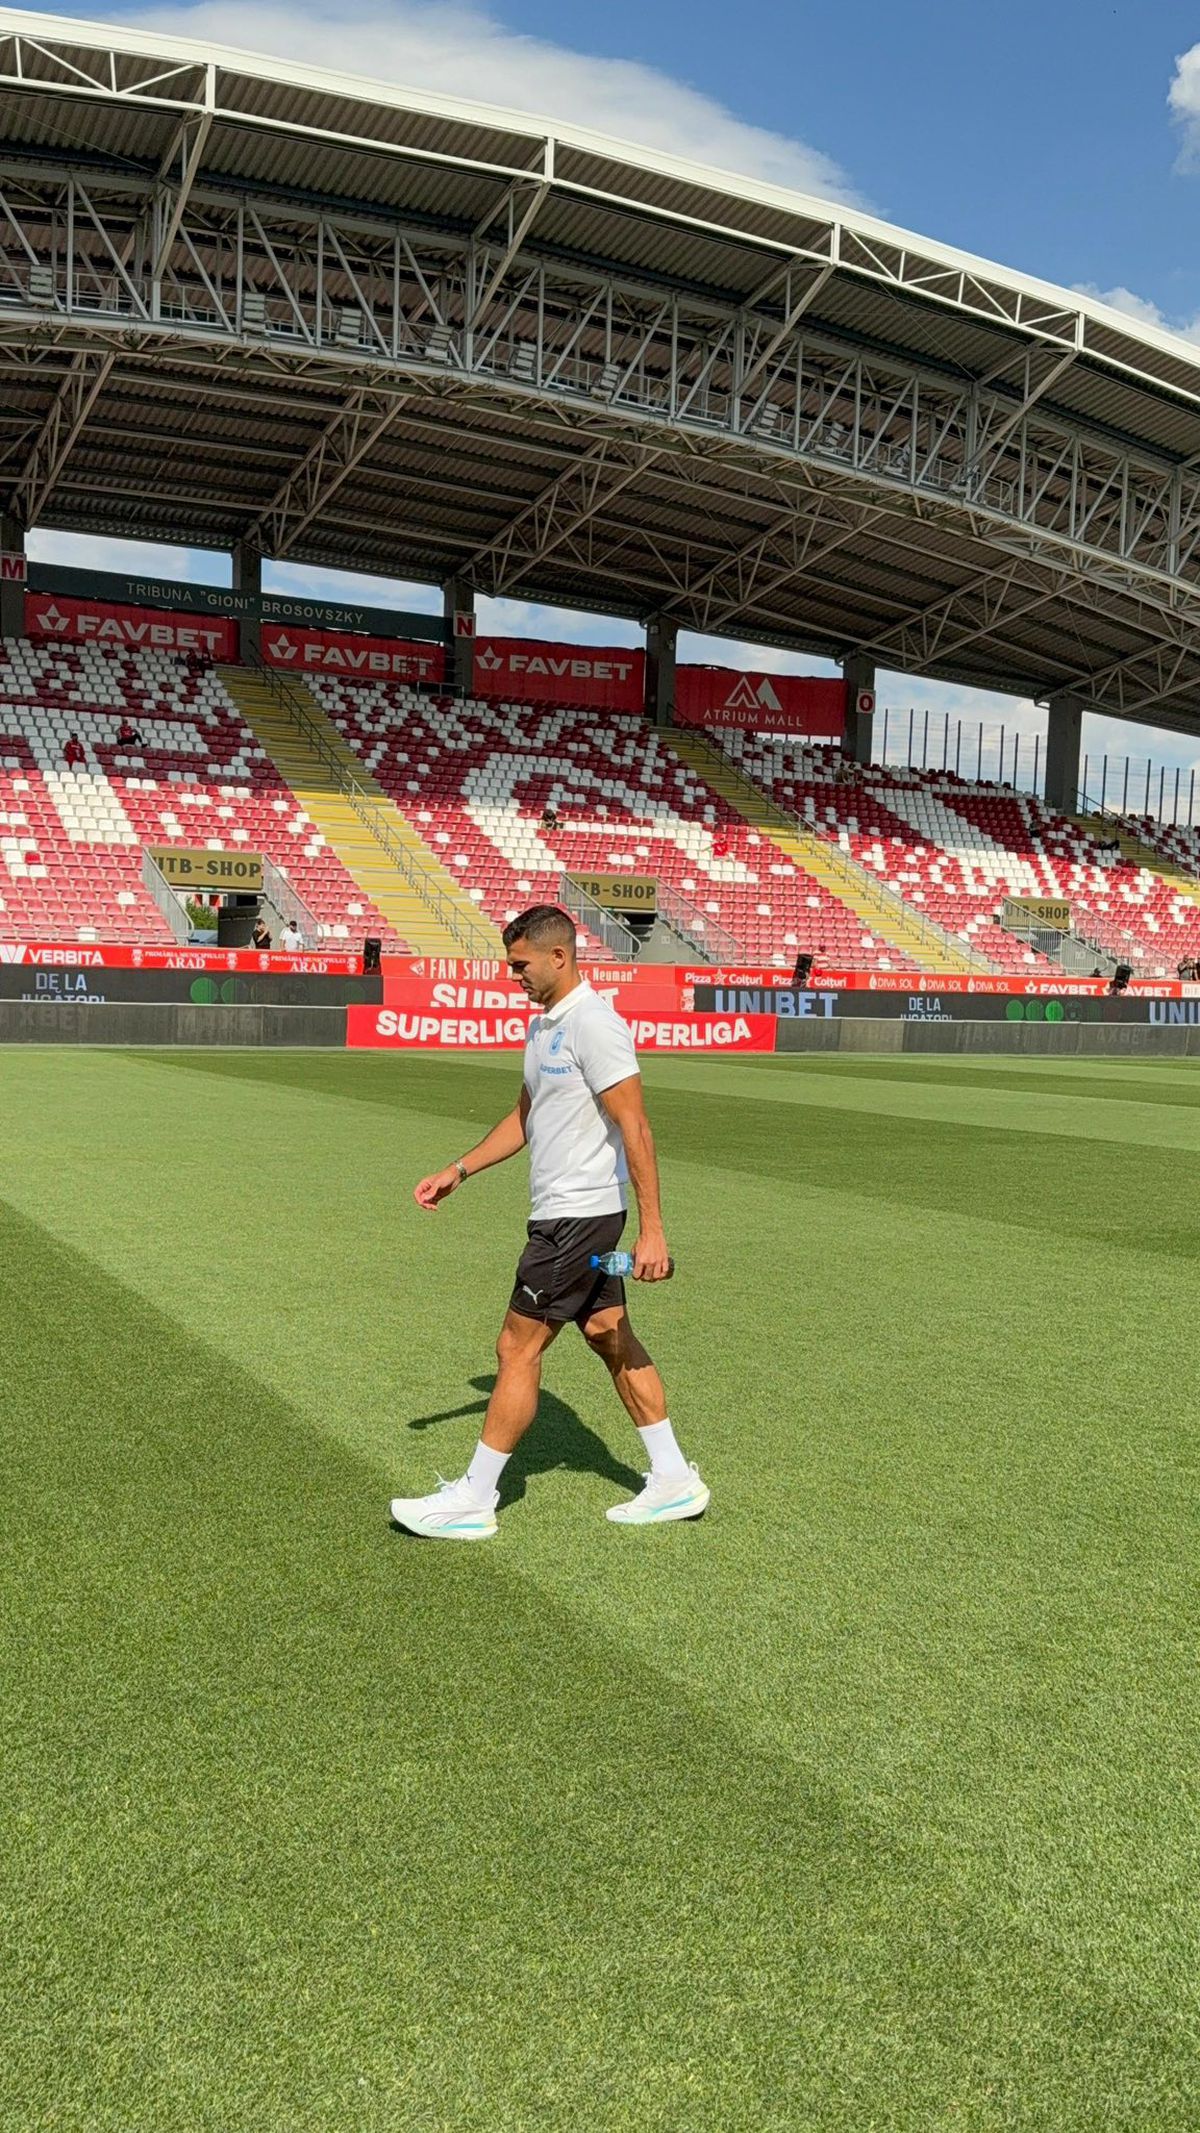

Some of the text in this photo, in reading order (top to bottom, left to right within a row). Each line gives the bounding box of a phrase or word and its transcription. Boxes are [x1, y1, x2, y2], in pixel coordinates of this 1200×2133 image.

[1, 557, 24, 579] M
[126, 582, 193, 602] TRIBUNA
[262, 600, 364, 624] BROSOVSZKY
[77, 615, 223, 650] FAVBET
[457, 616, 473, 636] N
[304, 644, 433, 676] FAVBET
[509, 655, 633, 681] FAVBET
[703, 709, 804, 727] ATRIUM MALL
[29, 949, 104, 965] VERBITA
[165, 957, 206, 969] ARAD
[290, 961, 328, 973] ARAD
[430, 959, 457, 979] FAN
[463, 959, 499, 980] SHOP
[65, 973, 87, 991] LA
[684, 972, 711, 984] Pizza
[772, 974, 793, 986] Pizz
[1040, 983, 1097, 995] FAVBET
[1123, 985, 1172, 997] AVBET
[714, 989, 838, 1017] UNIBET
[909, 996, 941, 1012] DE LA
[1149, 1000, 1200, 1024] UNI
[376, 1009, 535, 1044] SUPERLIG
